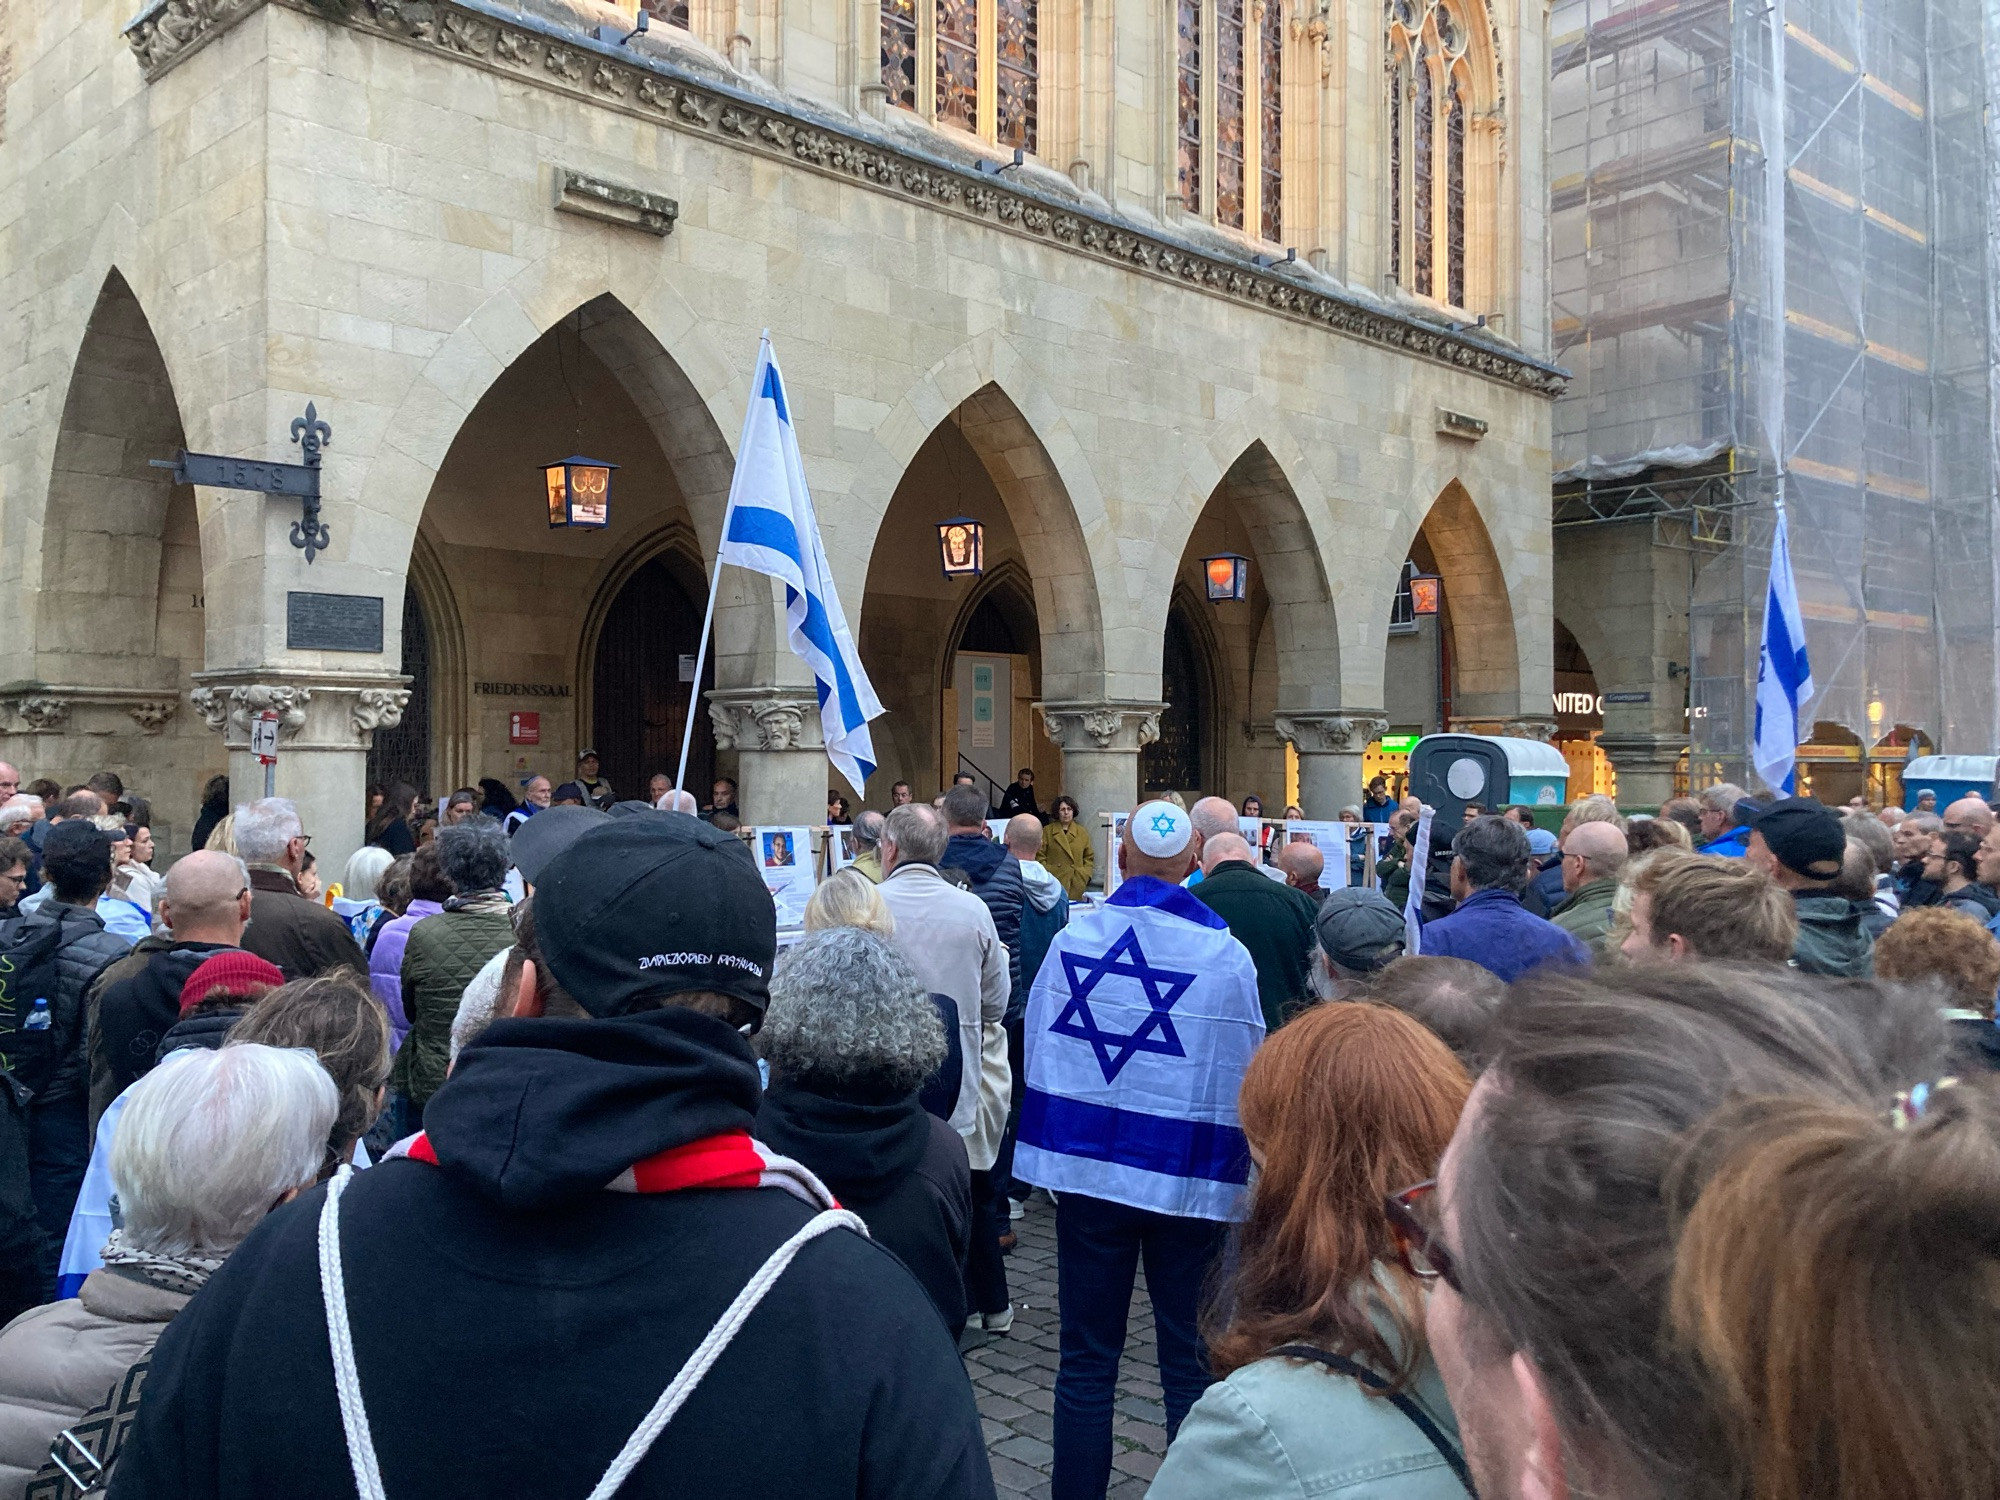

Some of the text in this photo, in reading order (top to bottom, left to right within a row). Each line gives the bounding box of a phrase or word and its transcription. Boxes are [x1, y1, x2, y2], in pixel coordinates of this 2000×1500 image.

[217, 461, 284, 490] 1578
[474, 682, 573, 697] FRIEDENSSAAL
[1553, 693, 1594, 714] NITED
